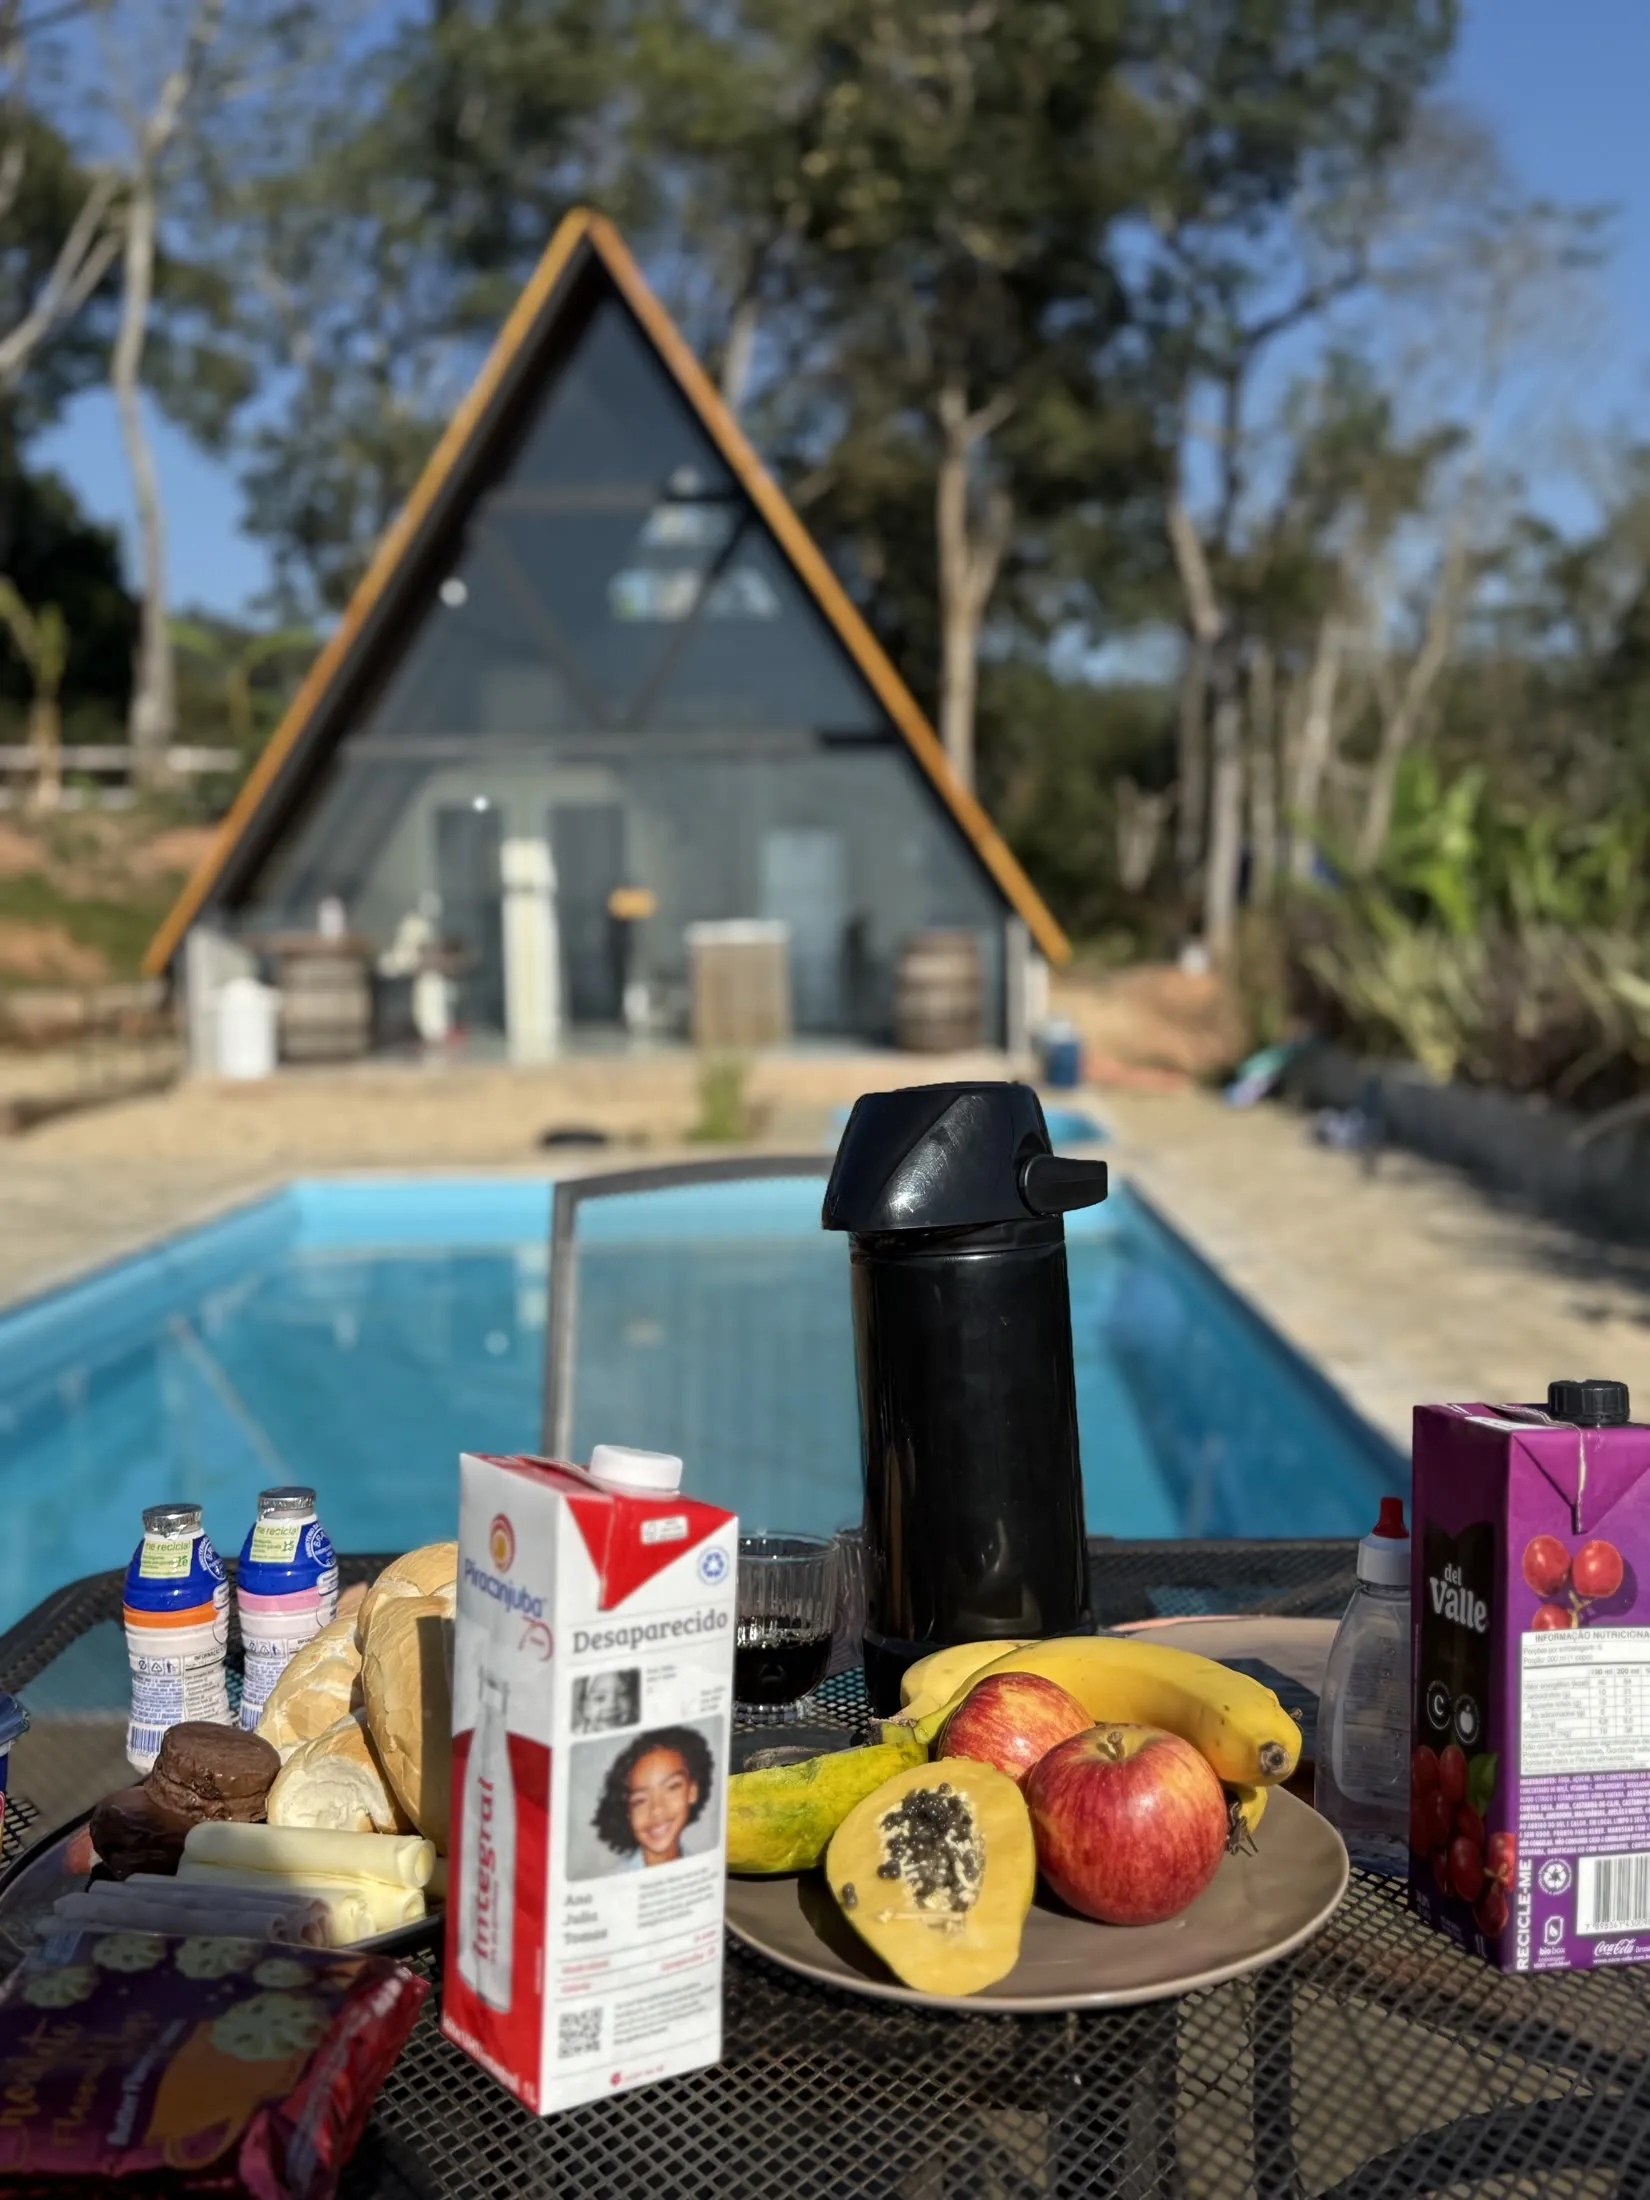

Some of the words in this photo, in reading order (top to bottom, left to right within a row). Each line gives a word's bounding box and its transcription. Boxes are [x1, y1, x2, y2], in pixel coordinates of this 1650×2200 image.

[157, 1539, 191, 1552] recicla!
[464, 1557, 543, 1619] Piracanjuba
[1444, 1563, 1462, 1587] del
[1429, 1576, 1487, 1633] Valle
[573, 1608, 728, 1654] Desaparecido
[1535, 1631, 1590, 1642] INFORMAÇÃO
[1516, 1859, 1532, 1970] RECICLE-ME
